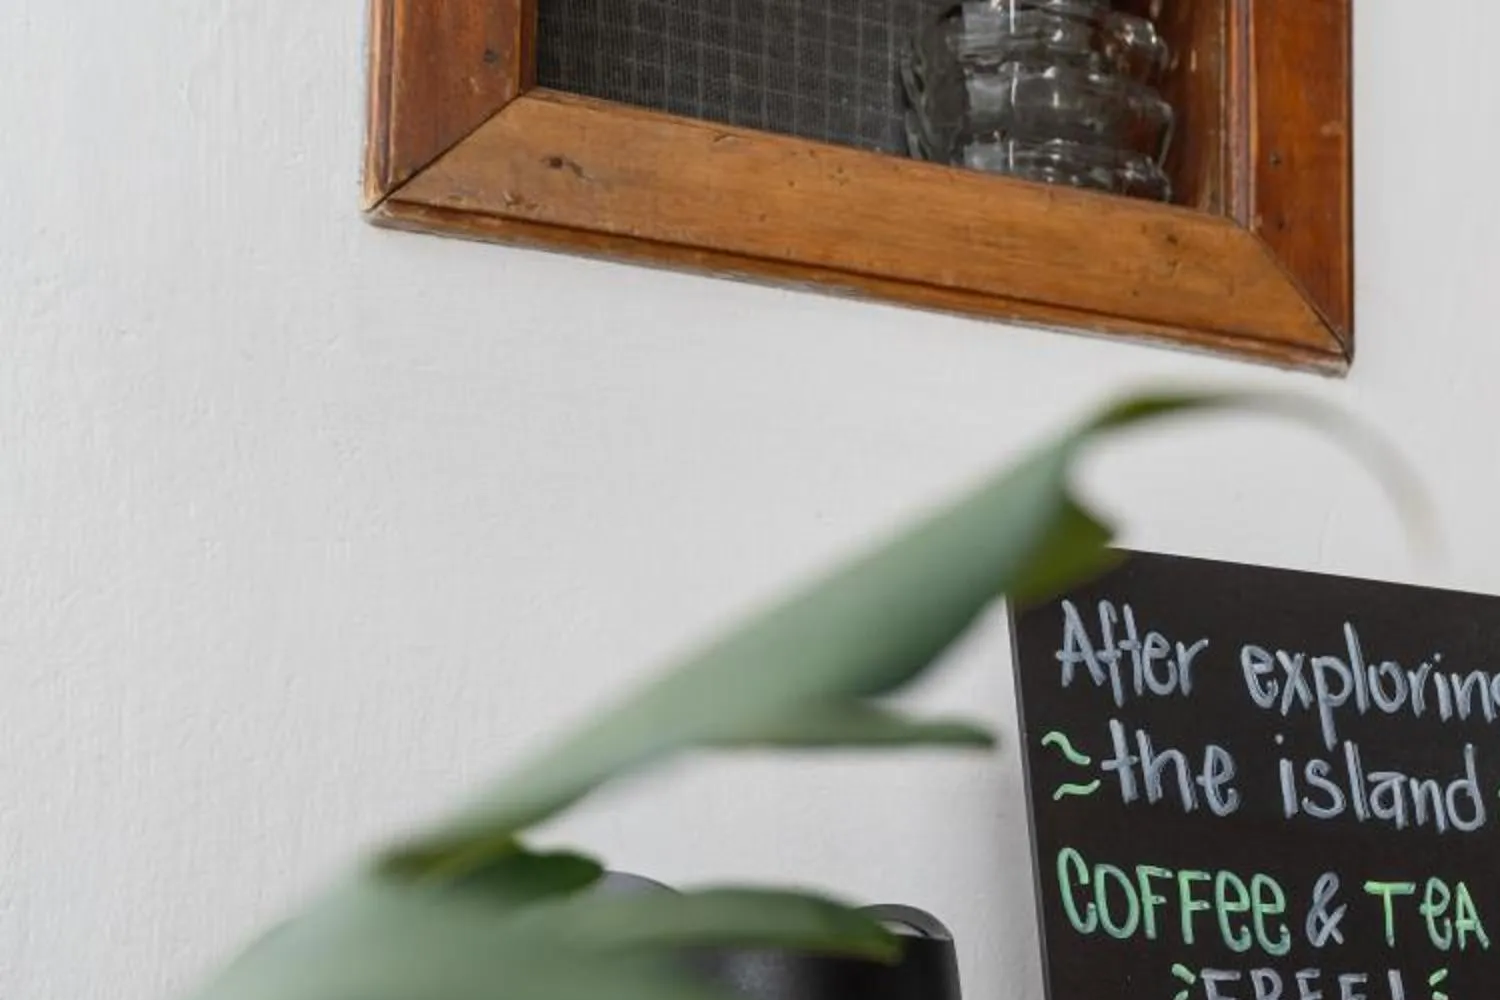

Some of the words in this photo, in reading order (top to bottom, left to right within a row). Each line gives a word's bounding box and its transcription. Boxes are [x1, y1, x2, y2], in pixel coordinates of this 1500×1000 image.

[1055, 599, 1209, 707] After
[1101, 719, 1240, 816] the
[1274, 735, 1487, 834] island
[1305, 872, 1348, 947] &
